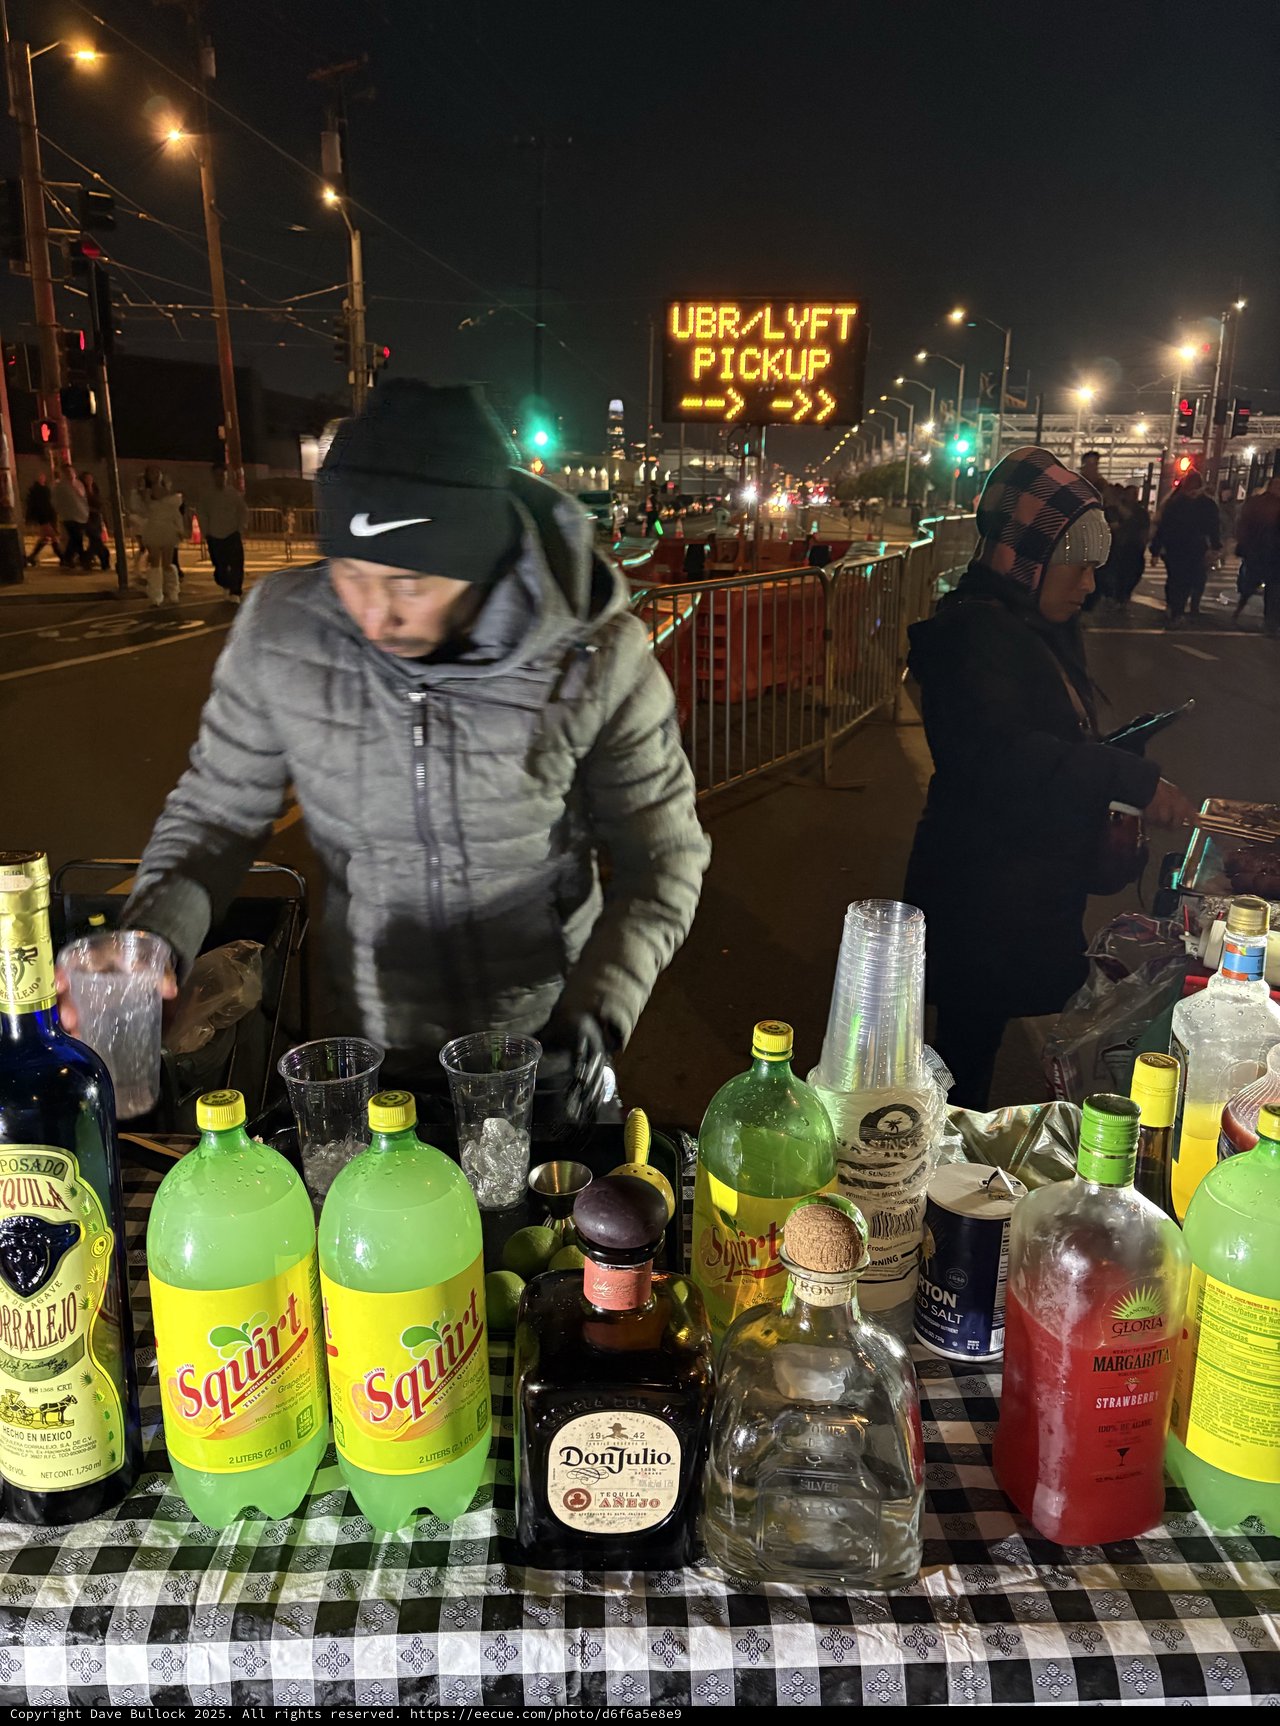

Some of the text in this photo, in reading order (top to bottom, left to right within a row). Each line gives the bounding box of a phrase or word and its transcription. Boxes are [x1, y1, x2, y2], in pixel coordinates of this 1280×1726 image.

[672, 305, 857, 340] UBR/LYFT
[694, 347, 830, 381] PICKUP
[0, 1177, 73, 1213] QUILA
[705, 1221, 783, 1283] Squirt
[870, 1254, 899, 1266] RNING
[31, 1280, 62, 1309] AGAVE
[931, 1304, 964, 1325] SALT
[1112, 1317, 1163, 1336] GLORIA
[178, 1292, 302, 1422] Squirt
[365, 1287, 480, 1422] Squirt
[1093, 1346, 1171, 1373] MARGARITA
[243, 1349, 304, 1409] Thirst Quencher
[433, 1381, 456, 1406] Thirst
[3, 1425, 25, 1440] HECHO
[27, 1432, 37, 1442] EN
[40, 1430, 72, 1442] MEXICO
[228, 1456, 235, 1464] 2
[236, 1451, 263, 1463] LITERS
[264, 1446, 278, 1457] (2.1
[425, 1447, 451, 1461] LITERS
[53, 1469, 74, 1478] CONT.
[76, 1463, 93, 1475] 1,750
[93, 1459, 102, 1469] ml
[800, 1480, 840, 1493] SILVER
[599, 1496, 661, 1508] AÑEJO
